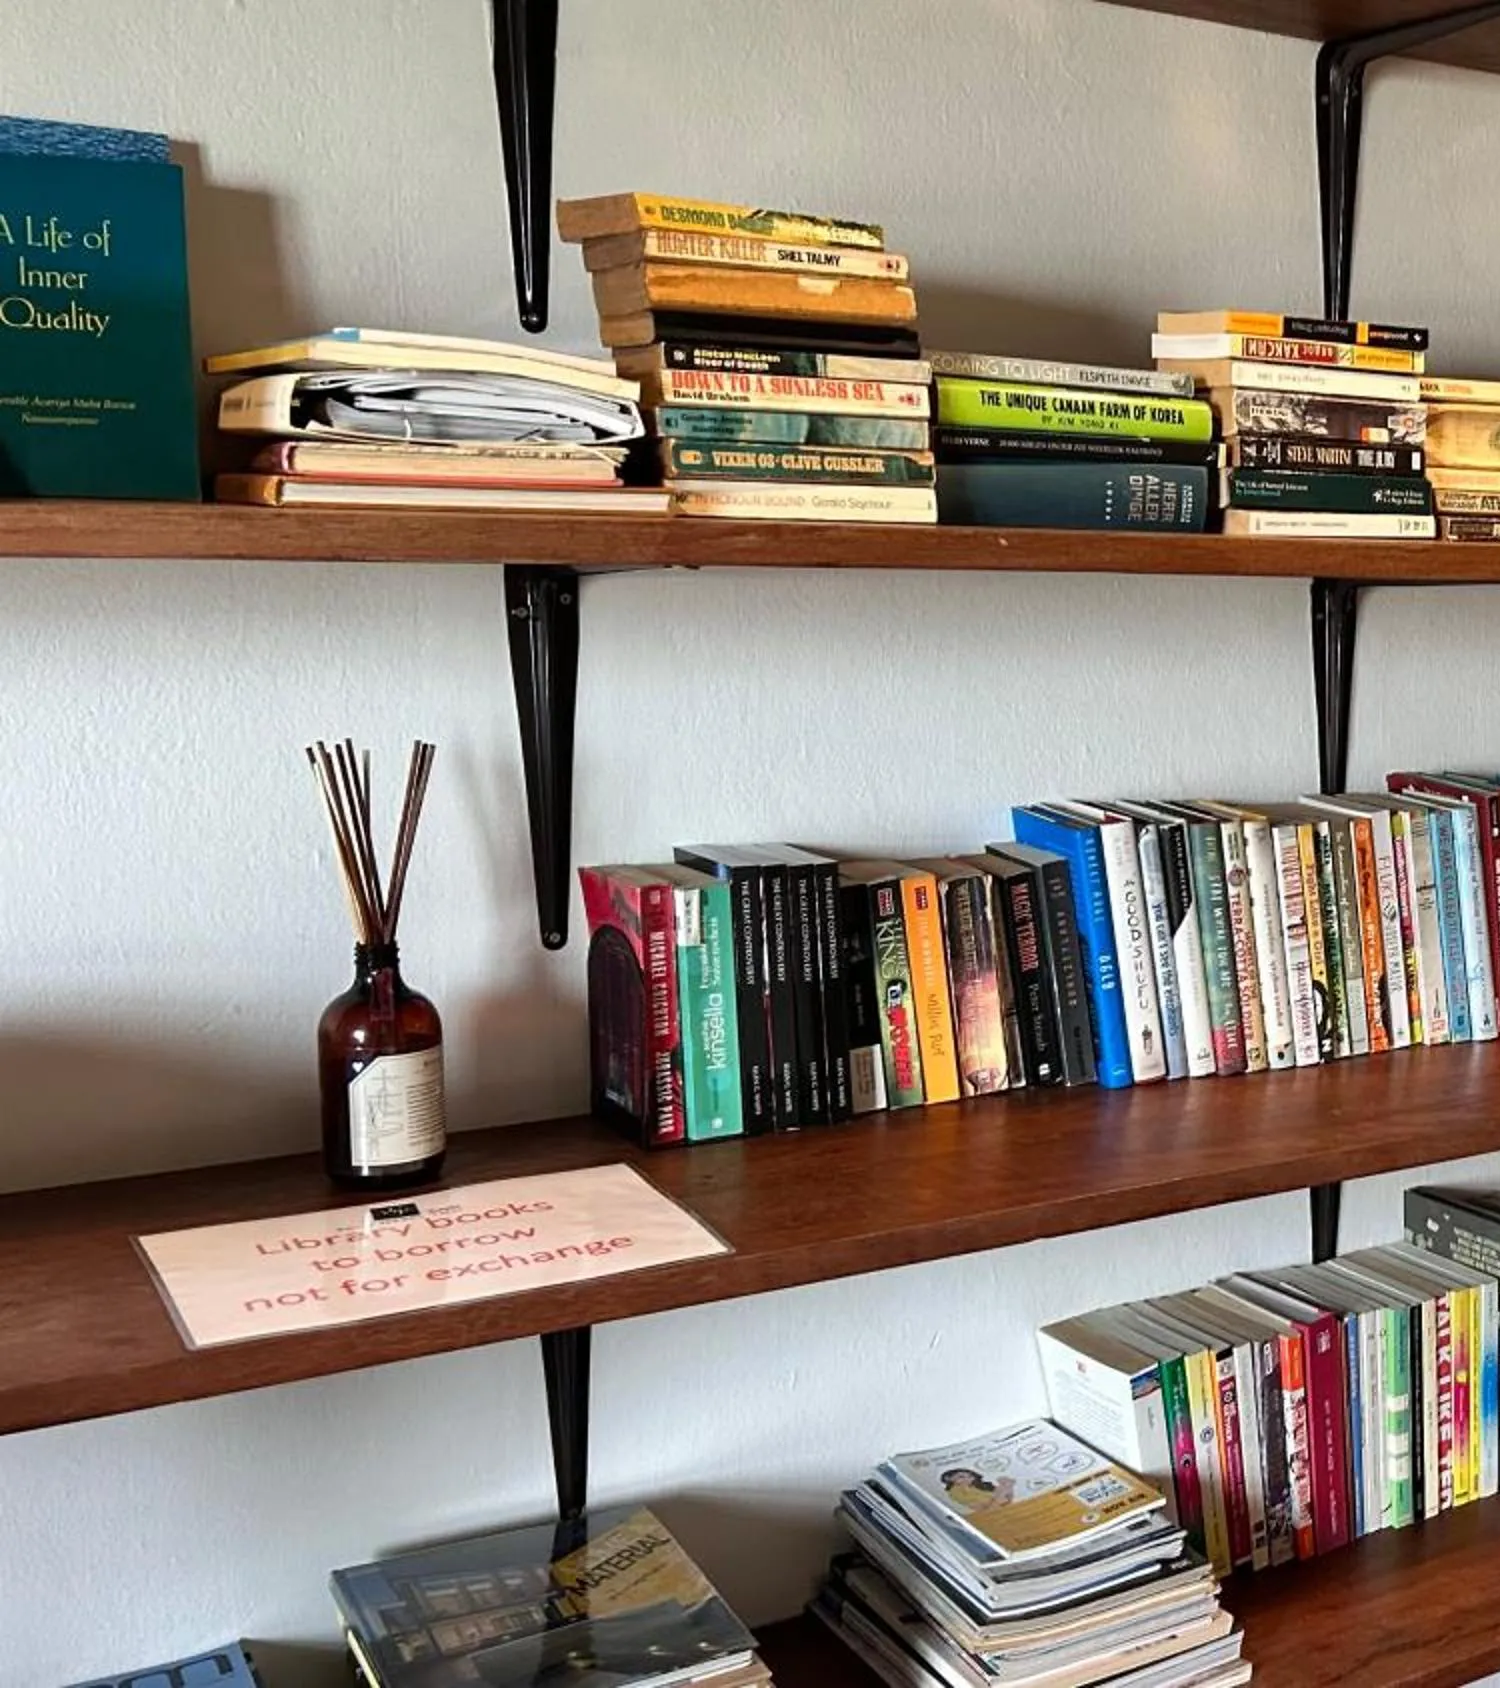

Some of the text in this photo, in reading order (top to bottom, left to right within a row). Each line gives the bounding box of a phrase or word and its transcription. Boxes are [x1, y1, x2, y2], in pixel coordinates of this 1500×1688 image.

[26, 216, 73, 252] Life
[82, 219, 112, 256] of
[658, 231, 841, 266] HUNTER KILLER SHEL TALMY
[19, 256, 88, 291] Inner
[0, 297, 111, 337] Quality
[930, 354, 998, 375] COMING
[1002, 361, 1024, 378] TO
[1028, 364, 1070, 382] LIGHT
[672, 371, 885, 401] DOWN TO A SUNLESS SEA
[673, 389, 702, 401] David
[980, 390, 1185, 425] THE UNIQUE CANAAN FARM OF KOREA
[712, 452, 756, 467] VIXEN
[782, 455, 821, 469] CLIVE
[824, 457, 885, 473] CUSSLER
[740, 880, 749, 895] THE
[772, 877, 782, 893] THE
[799, 879, 808, 894] THE
[1011, 882, 1032, 920] MAGIC
[1151, 903, 1164, 922] you
[875, 920, 897, 980] KING
[1018, 922, 1039, 972] TERROR
[704, 992, 728, 1071] kinsella
[255, 1199, 554, 1257] Library books
[312, 1225, 537, 1273] to borrow
[244, 1235, 635, 1313] not for exchange
[1436, 1296, 1452, 1511] TALK LIKE TED
